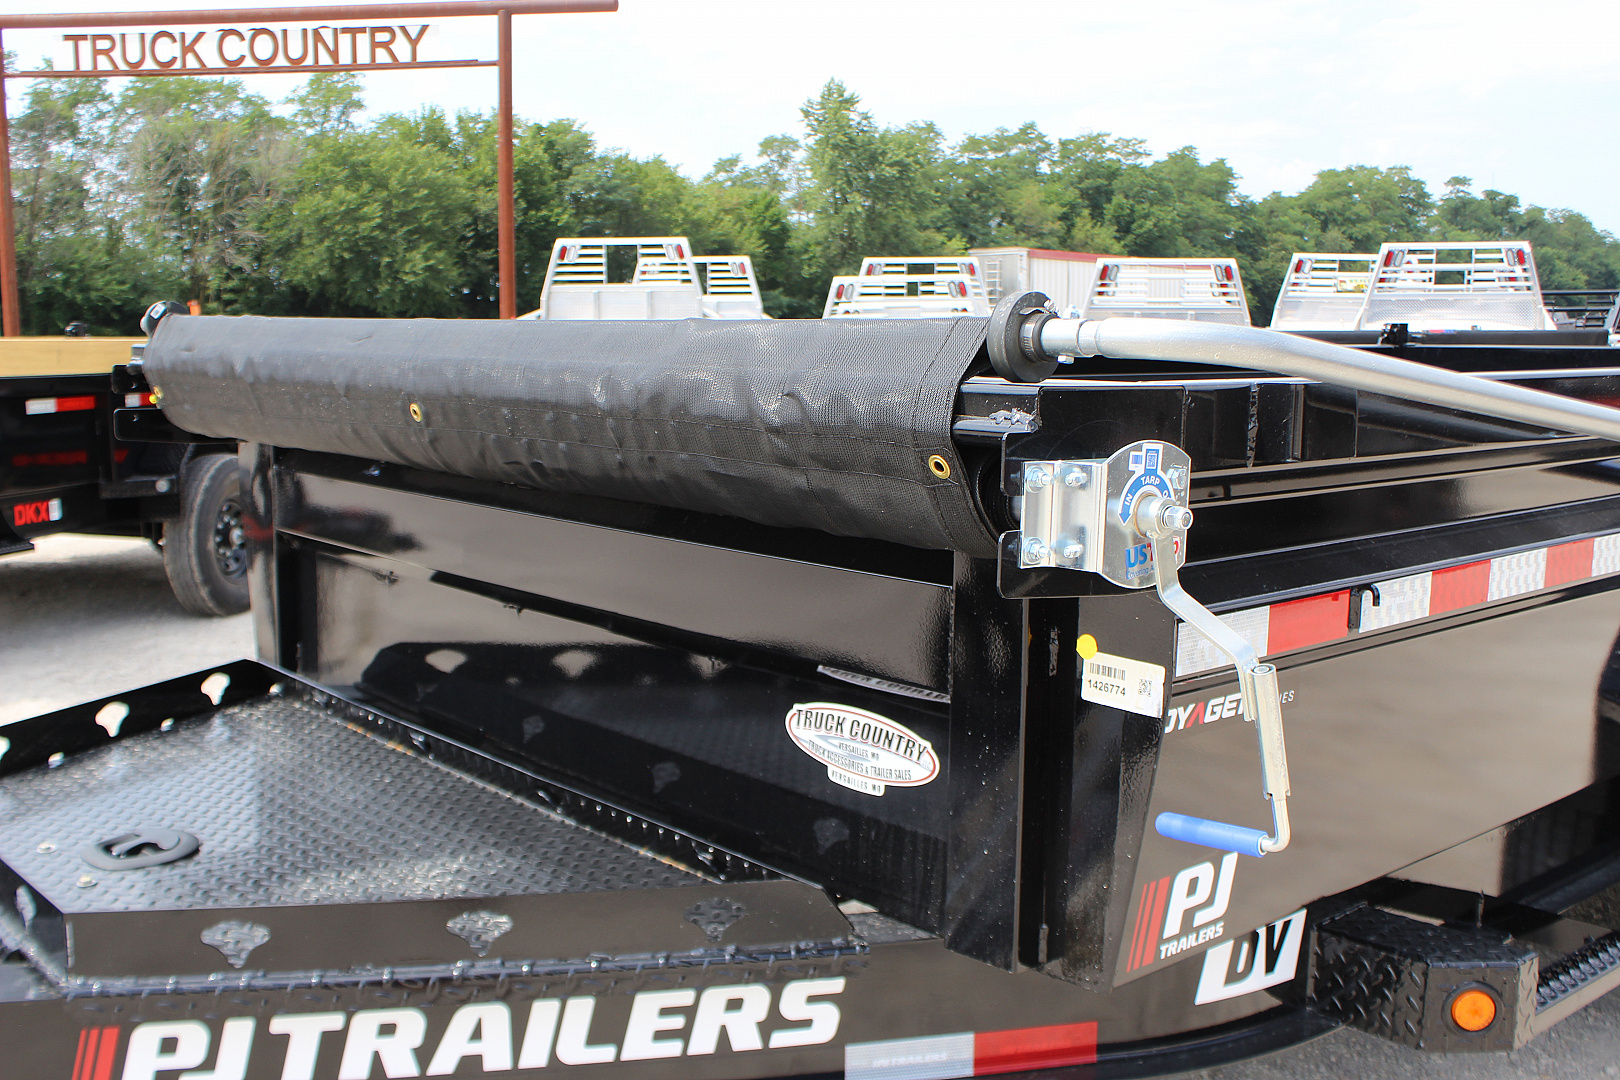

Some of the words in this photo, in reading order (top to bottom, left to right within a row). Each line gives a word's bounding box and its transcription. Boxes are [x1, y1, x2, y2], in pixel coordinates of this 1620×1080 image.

[62, 31, 207, 70] TRUCK
[216, 25, 430, 66] COUNTRY
[1124, 493, 1133, 506] IN
[1140, 475, 1160, 486] TARP
[13, 500, 49, 527] DKX
[1087, 679, 1126, 696] 1426774
[1164, 693, 1244, 734] OYAGE
[1279, 690, 1295, 704] IES
[795, 709, 846, 736] TRUCK
[849, 719, 927, 762] COUNTRY
[808, 739, 826, 758] TRUCK
[826, 752, 864, 773] ACCESSORIES
[870, 766, 893, 780] TRAILER
[893, 769, 912, 781] SALES
[871, 783, 881, 794] MO
[1163, 851, 1238, 940] PJ
[1159, 920, 1225, 960] TRAILERS
[1223, 917, 1294, 988] DV
[121, 1018, 257, 1080] PJ
[269, 976, 847, 1080] TRAILERS
